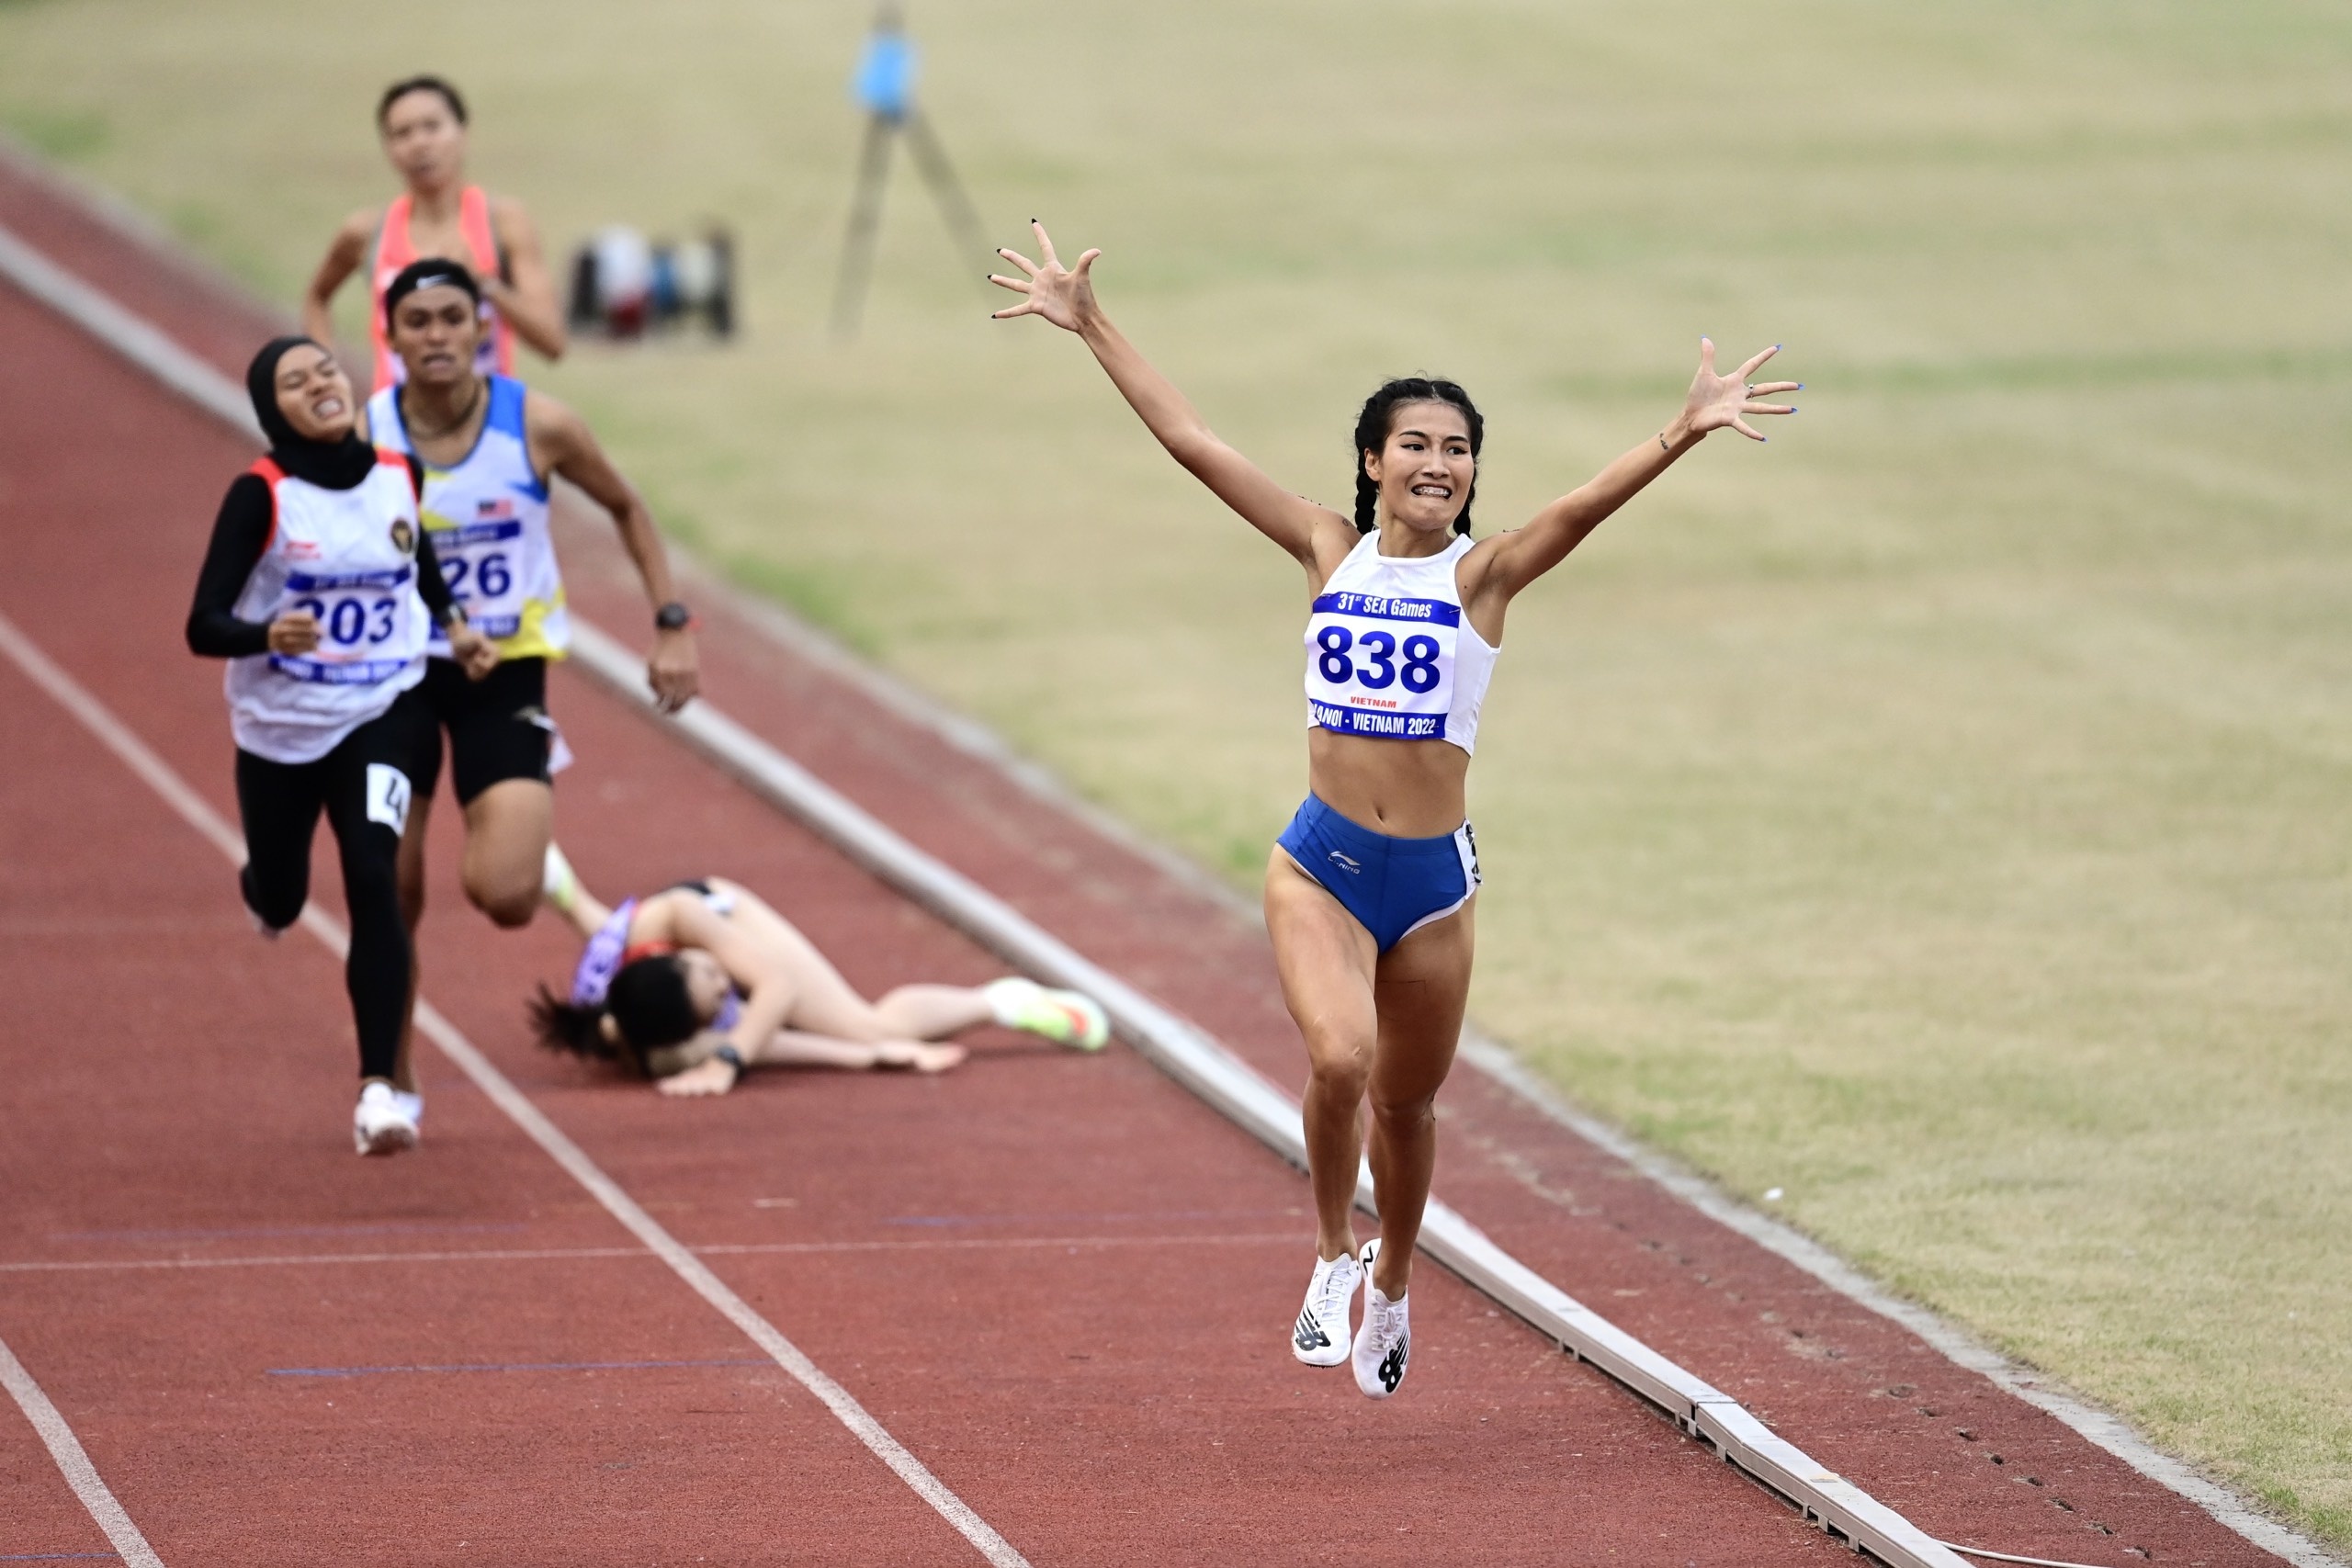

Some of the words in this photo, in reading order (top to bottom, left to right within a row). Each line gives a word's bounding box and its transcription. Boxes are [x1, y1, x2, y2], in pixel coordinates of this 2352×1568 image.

[1363, 597, 1387, 615] SEA
[1391, 600, 1431, 617] Games
[1317, 626, 1440, 694] 838
[1351, 696, 1396, 708] VIETNAM
[1353, 713, 1405, 734] VIETNAM
[1408, 718, 1436, 735] 2022
